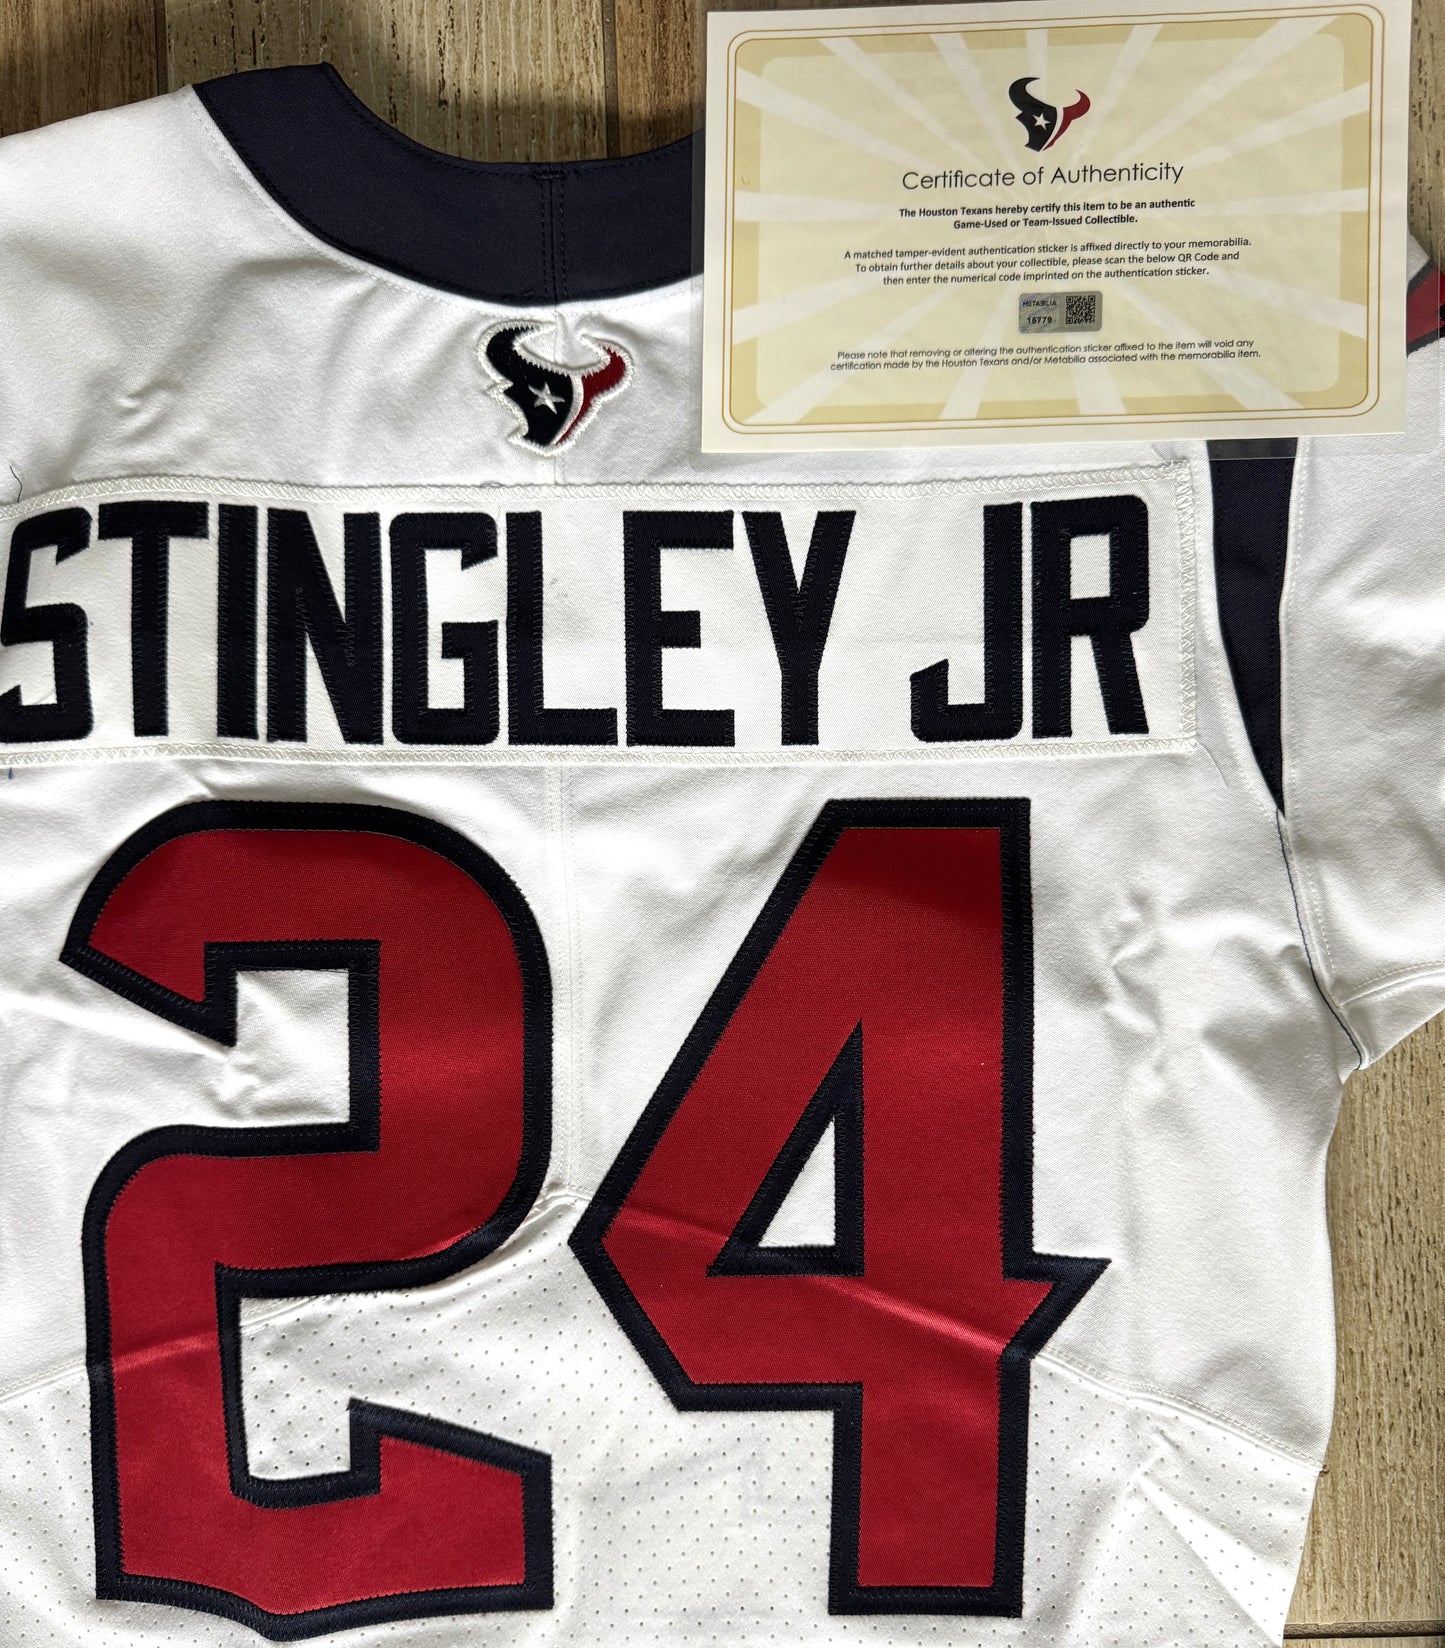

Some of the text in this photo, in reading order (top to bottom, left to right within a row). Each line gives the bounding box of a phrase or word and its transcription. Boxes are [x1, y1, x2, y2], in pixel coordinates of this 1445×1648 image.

[902, 162, 1184, 190] Certificate of Authenticity
[899, 208, 916, 217] The
[919, 208, 958, 217] Houston
[960, 207, 993, 215] Texans
[995, 205, 1028, 215] hereby
[1030, 203, 1061, 214] certify
[1063, 202, 1081, 212] this
[1083, 202, 1105, 211] item
[1107, 202, 1118, 210] to
[1120, 200, 1132, 210] be
[1149, 198, 1195, 208] authentic
[954, 218, 1008, 229] Game-Used
[1022, 216, 1082, 227] Team-Issued
[1085, 214, 1138, 224] Collectible.
[844, 237, 1251, 261] A matched tamper-evident authentication sticker is affixed directly to your memorabilia.
[856, 264, 866, 272] To
[869, 262, 898, 272] obtain
[900, 262, 933, 271] further
[935, 260, 965, 270] details
[967, 260, 994, 269] about
[996, 261, 1017, 270] your
[1020, 257, 1069, 267] collectible,
[1072, 256, 1102, 267] please
[1128, 255, 1144, 264] the
[1146, 254, 1176, 263] below
[1178, 252, 1192, 262] QR
[1194, 252, 1219, 261] Code
[1222, 251, 1239, 260] and
[883, 276, 904, 285] then
[906, 276, 931, 284] enter
[933, 274, 948, 284] the
[951, 273, 996, 283] numerical
[999, 272, 1021, 281] code
[1023, 271, 1069, 282] imprinted
[1086, 270, 1102, 278] the
[1104, 268, 1173, 278] authentication
[1175, 266, 1209, 276] sticker.
[831, 361, 881, 370] certification
[883, 360, 909, 369] made
[912, 360, 923, 369] by
[942, 358, 977, 367] Houston
[980, 358, 1009, 366] Texans
[1011, 356, 1042, 365] and/or
[1044, 355, 1086, 364] Metabilia
[1088, 353, 1137, 363] associated
[1139, 353, 1158, 361] with
[1161, 352, 1176, 360] the
[1178, 350, 1236, 360] memorabilia
[1238, 350, 1261, 358] item.
[868, 351, 888, 359] note
[890, 350, 907, 358] that
[910, 349, 951, 361] removing
[964, 347, 997, 359] altering
[1016, 345, 1081, 354] authentication
[1084, 344, 1112, 352] sticker
[1114, 343, 1144, 351] affixed
[1147, 343, 1156, 351] to
[1158, 342, 1173, 350] the
[1198, 340, 1212, 348] will
[1214, 340, 1234, 348] void
[1236, 340, 1254, 348] any
[0, 494, 1149, 746] STINGLEY JR
[59, 798, 1112, 1640] 24
